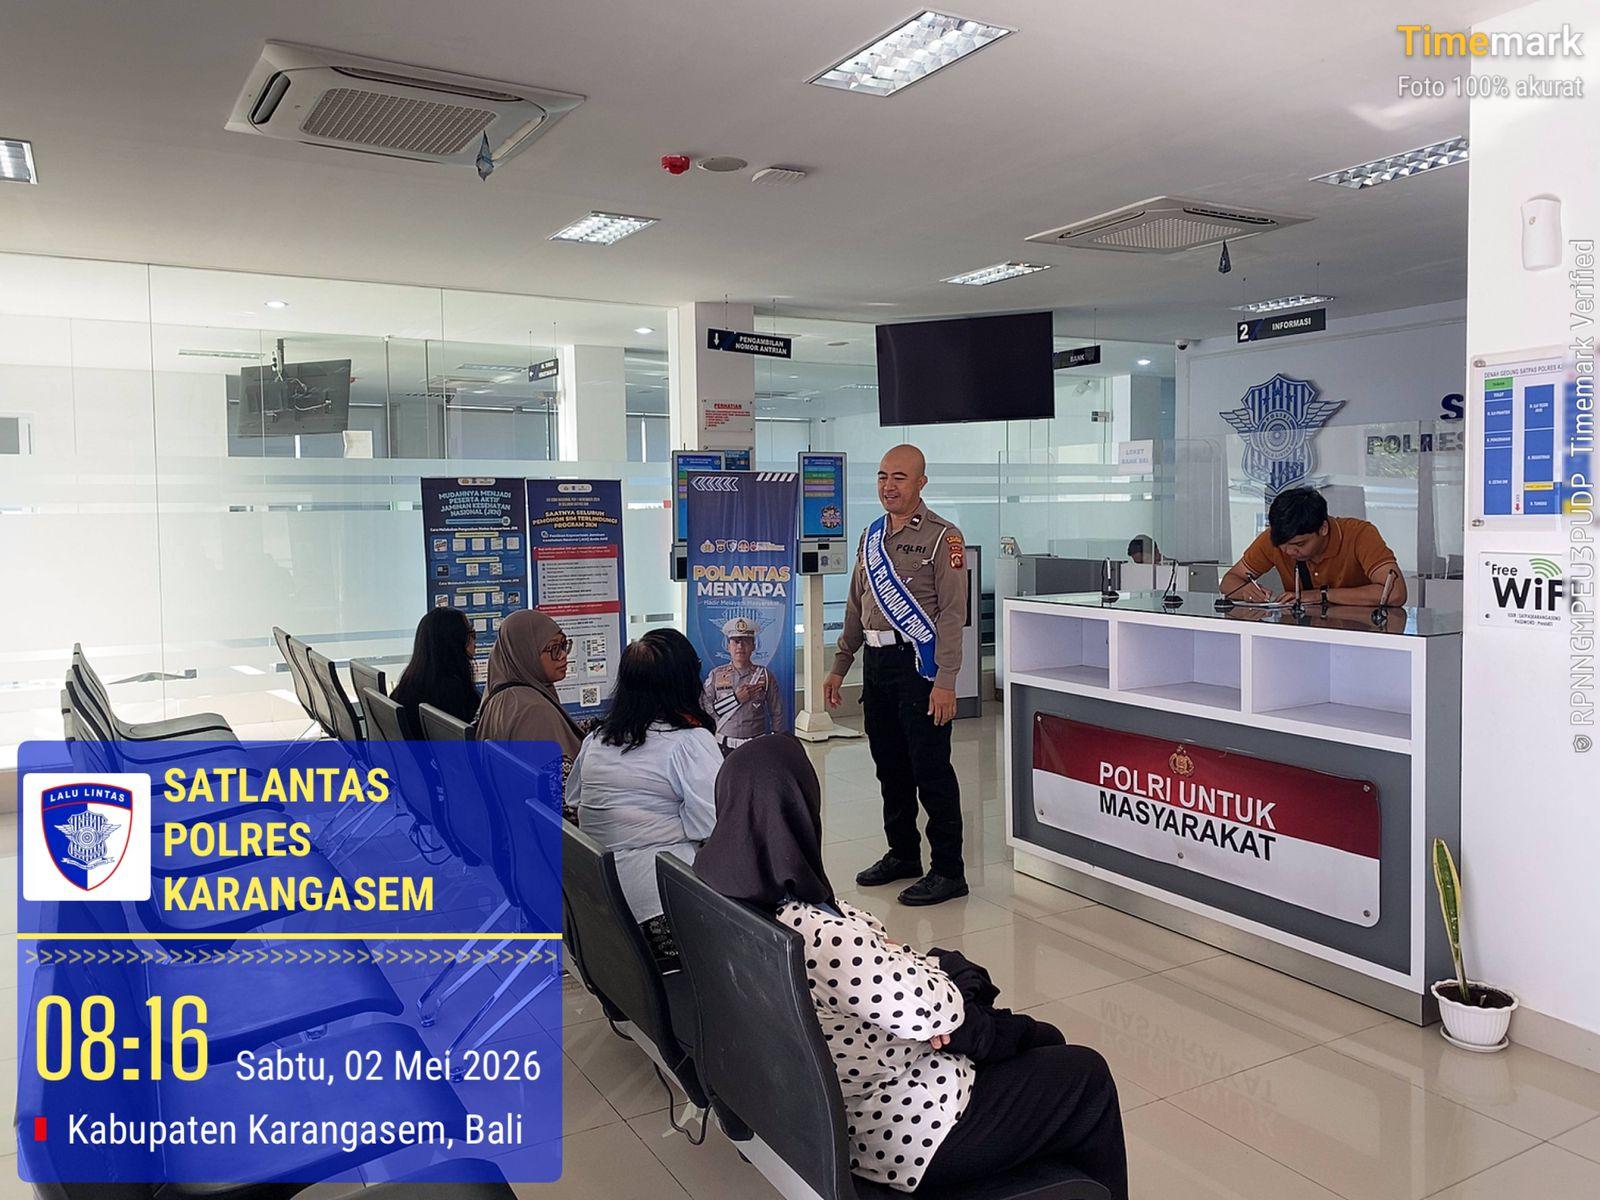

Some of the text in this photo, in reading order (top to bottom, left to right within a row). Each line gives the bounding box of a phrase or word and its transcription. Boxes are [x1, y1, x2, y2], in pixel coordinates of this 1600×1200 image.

[1271, 317, 1312, 331] INFORMASI
[1239, 324, 1249, 340] 2
[739, 336, 784, 347] PENGAMBILAN
[735, 343, 787, 355] NOMOR ANTRIAN
[1069, 354, 1085, 363] BANK
[1484, 371, 1499, 379] DENAH
[1500, 369, 1519, 377] GEDUNG
[1520, 367, 1538, 375] SATPAS
[1538, 364, 1557, 372] POLRES
[438, 490, 512, 500] MUDAHNYA MENJADI
[440, 502, 511, 512] JAMINAN KESEHATAN
[450, 509, 483, 517] NASIONAL
[545, 510, 576, 518] SAATNYA
[532, 516, 565, 526] PEMOHON
[577, 516, 618, 524] TERLINDUNGI
[896, 543, 927, 554] POLRI
[693, 565, 791, 582] POLANTAS
[1491, 564, 1518, 577] Free
[697, 582, 786, 597] MENYAPA
[873, 565, 913, 621] PELAYANAN
[900, 613, 934, 645] PRIMA
[1100, 761, 1277, 830] POLRI UNTUK
[1099, 790, 1276, 862] MASYARAKAT
